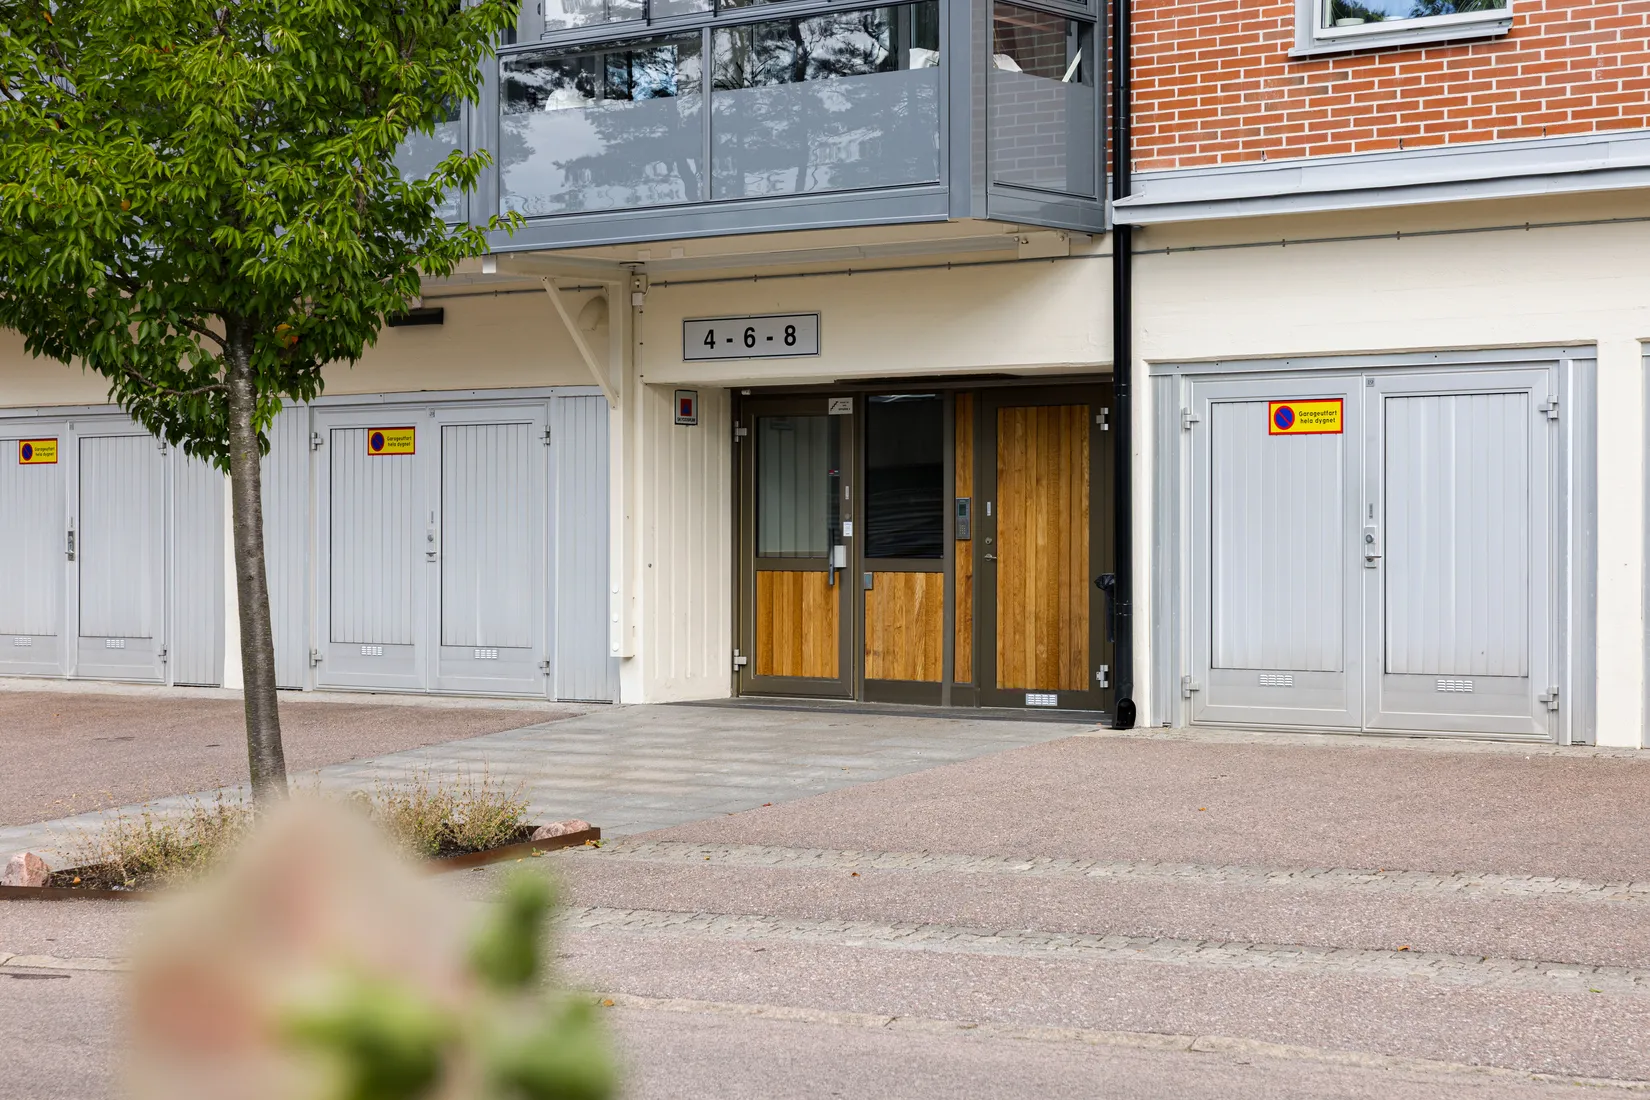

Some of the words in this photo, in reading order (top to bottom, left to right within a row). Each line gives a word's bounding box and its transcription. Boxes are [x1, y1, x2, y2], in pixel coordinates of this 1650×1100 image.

[704, 329, 716, 349] 4
[744, 327, 756, 348] 6
[784, 324, 796, 346] 8
